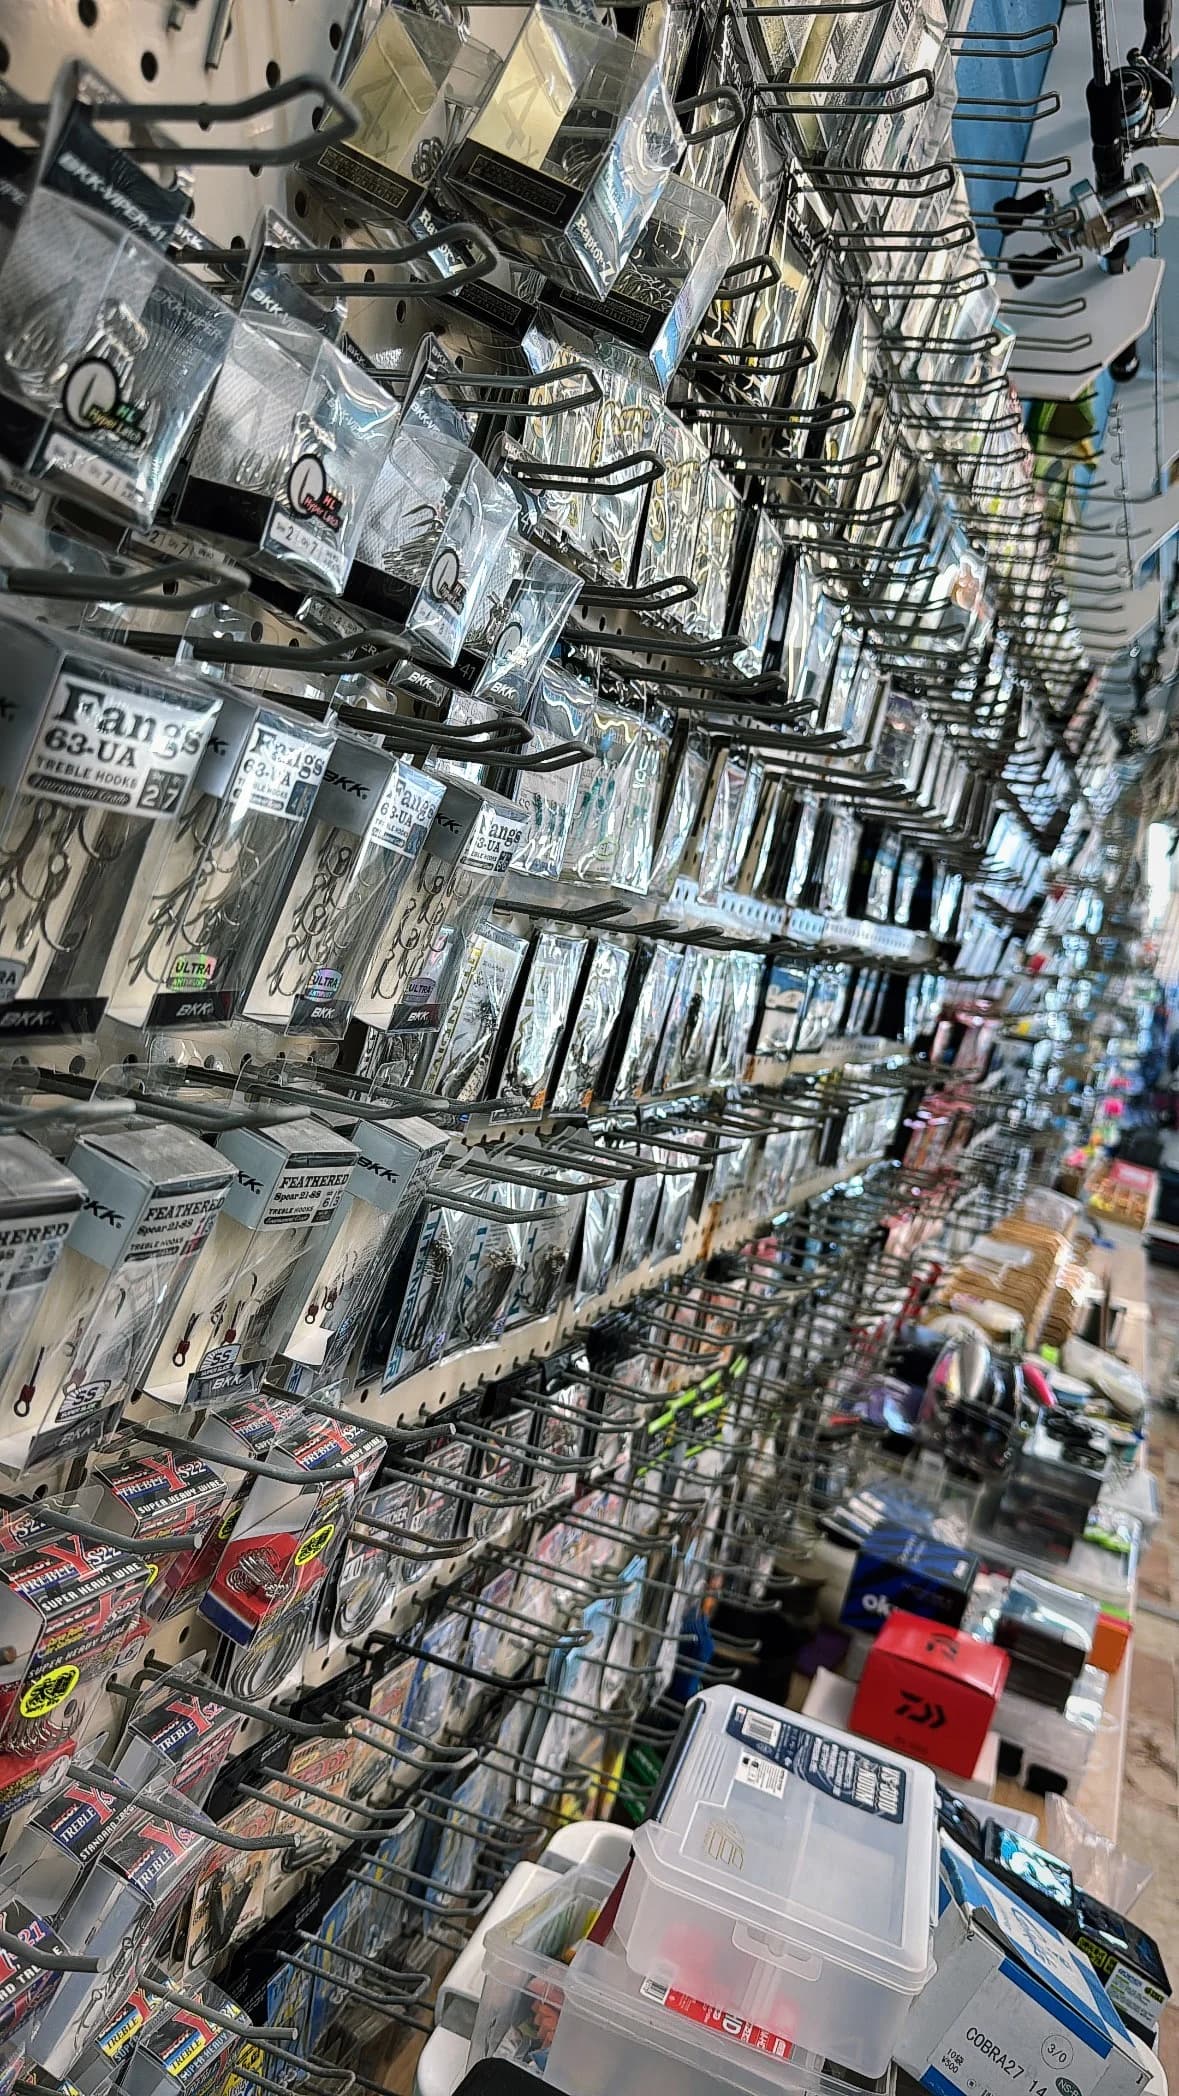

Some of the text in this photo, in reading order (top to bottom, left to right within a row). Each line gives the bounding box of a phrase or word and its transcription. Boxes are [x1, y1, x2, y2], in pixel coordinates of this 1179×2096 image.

[57, 151, 167, 241] BKK-VIPER-41
[410, 671, 435, 689] BKK
[490, 681, 517, 699] BKK
[53, 681, 204, 760] Fangs
[45, 727, 138, 769] 63-UA
[36, 755, 140, 791] TREBLE HOOKS
[175, 960, 212, 976] ULTRA
[313, 973, 338, 989] ULTRA
[409, 983, 433, 995] ULTRA
[176, 1003, 212, 1017] BKK
[310, 1006, 336, 1019] BKK
[407, 1011, 430, 1022] BKK
[278, 1173, 350, 1190] FEATHERED
[144, 1197, 226, 1222] FEATHERED
[268, 1207, 294, 1216] TREBLE
[273, 1191, 299, 1203] Spear
[363, 1436, 382, 1453] WIRE
[138, 1479, 223, 1515] SUPER HEAVY WIRE
[19, 1563, 77, 1593] TREBLE
[41, 1561, 143, 1613] SUPER HEAVY WIRE
[158, 1719, 196, 1751] TREBLE
[50, 1803, 78, 1832] DECOY
[60, 1806, 97, 1843] TREBLE
[79, 1820, 118, 1860] STANDARD
[136, 1851, 174, 1891] TREBLE
[106, 2018, 138, 2051] TREBLE
[171, 2038, 202, 2071] TREBLE
[966, 2027, 1025, 2079] COBRA27
[1047, 2043, 1068, 2064] 3/0
